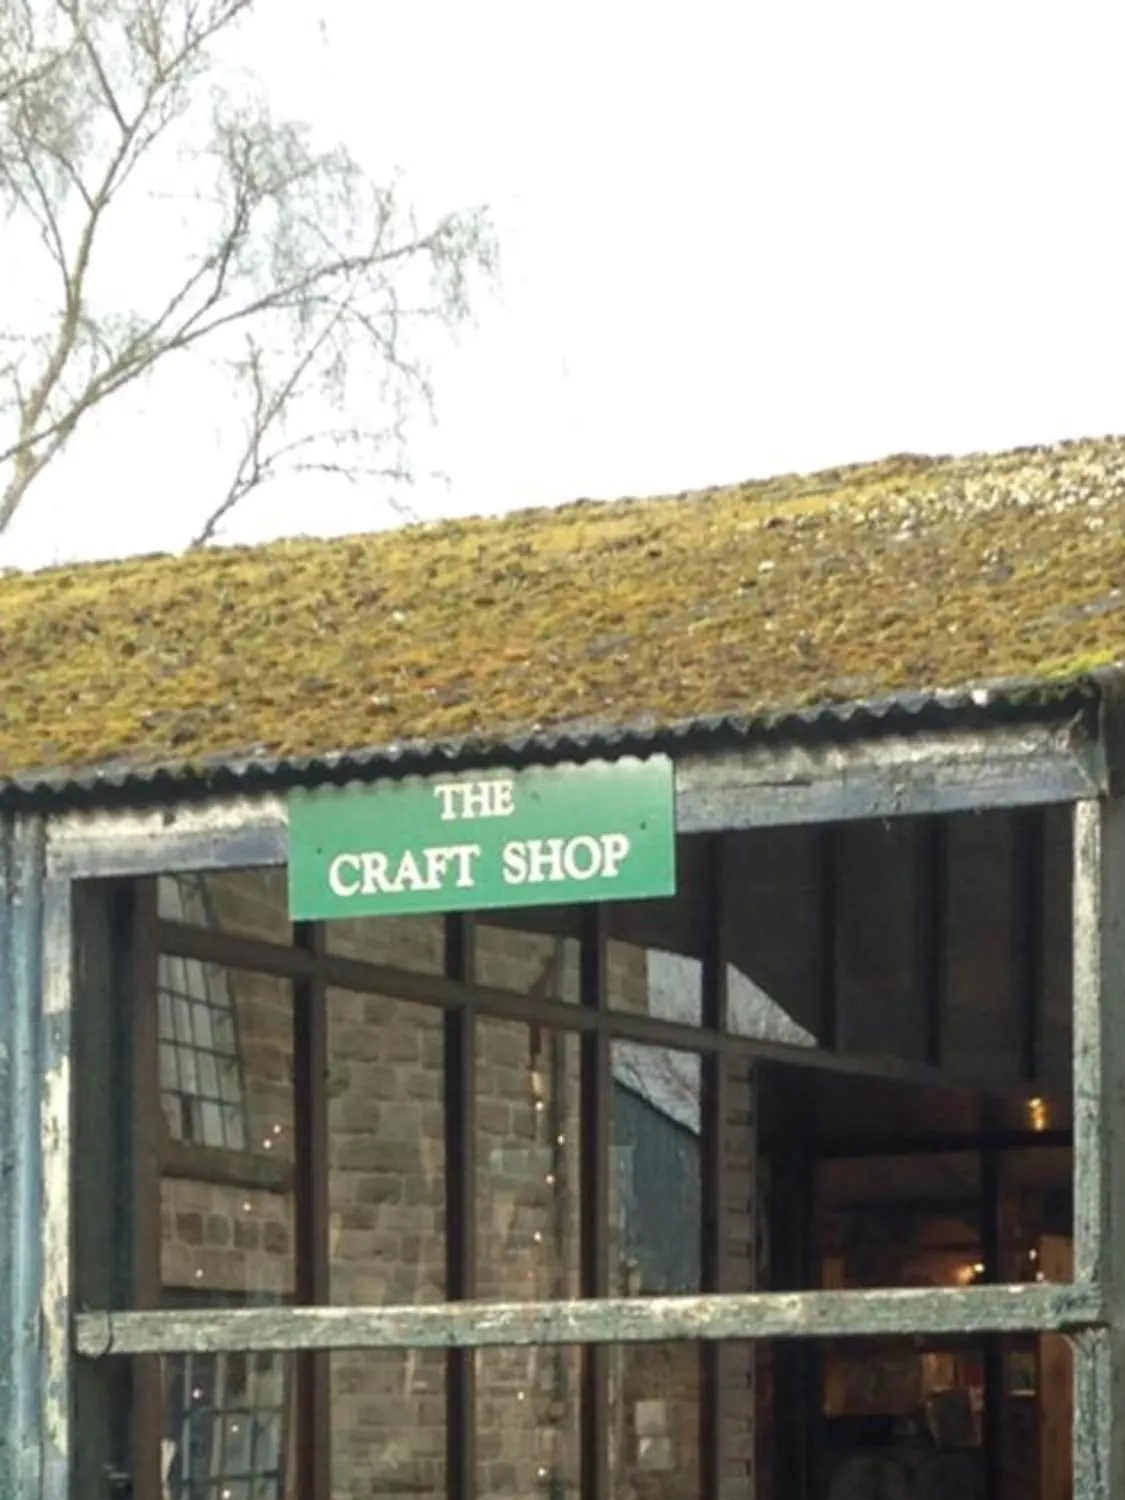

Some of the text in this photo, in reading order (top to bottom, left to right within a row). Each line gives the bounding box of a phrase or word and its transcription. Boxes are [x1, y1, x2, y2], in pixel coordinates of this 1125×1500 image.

[434, 779, 515, 820] THE
[329, 833, 631, 897] CRAFT SHOP
